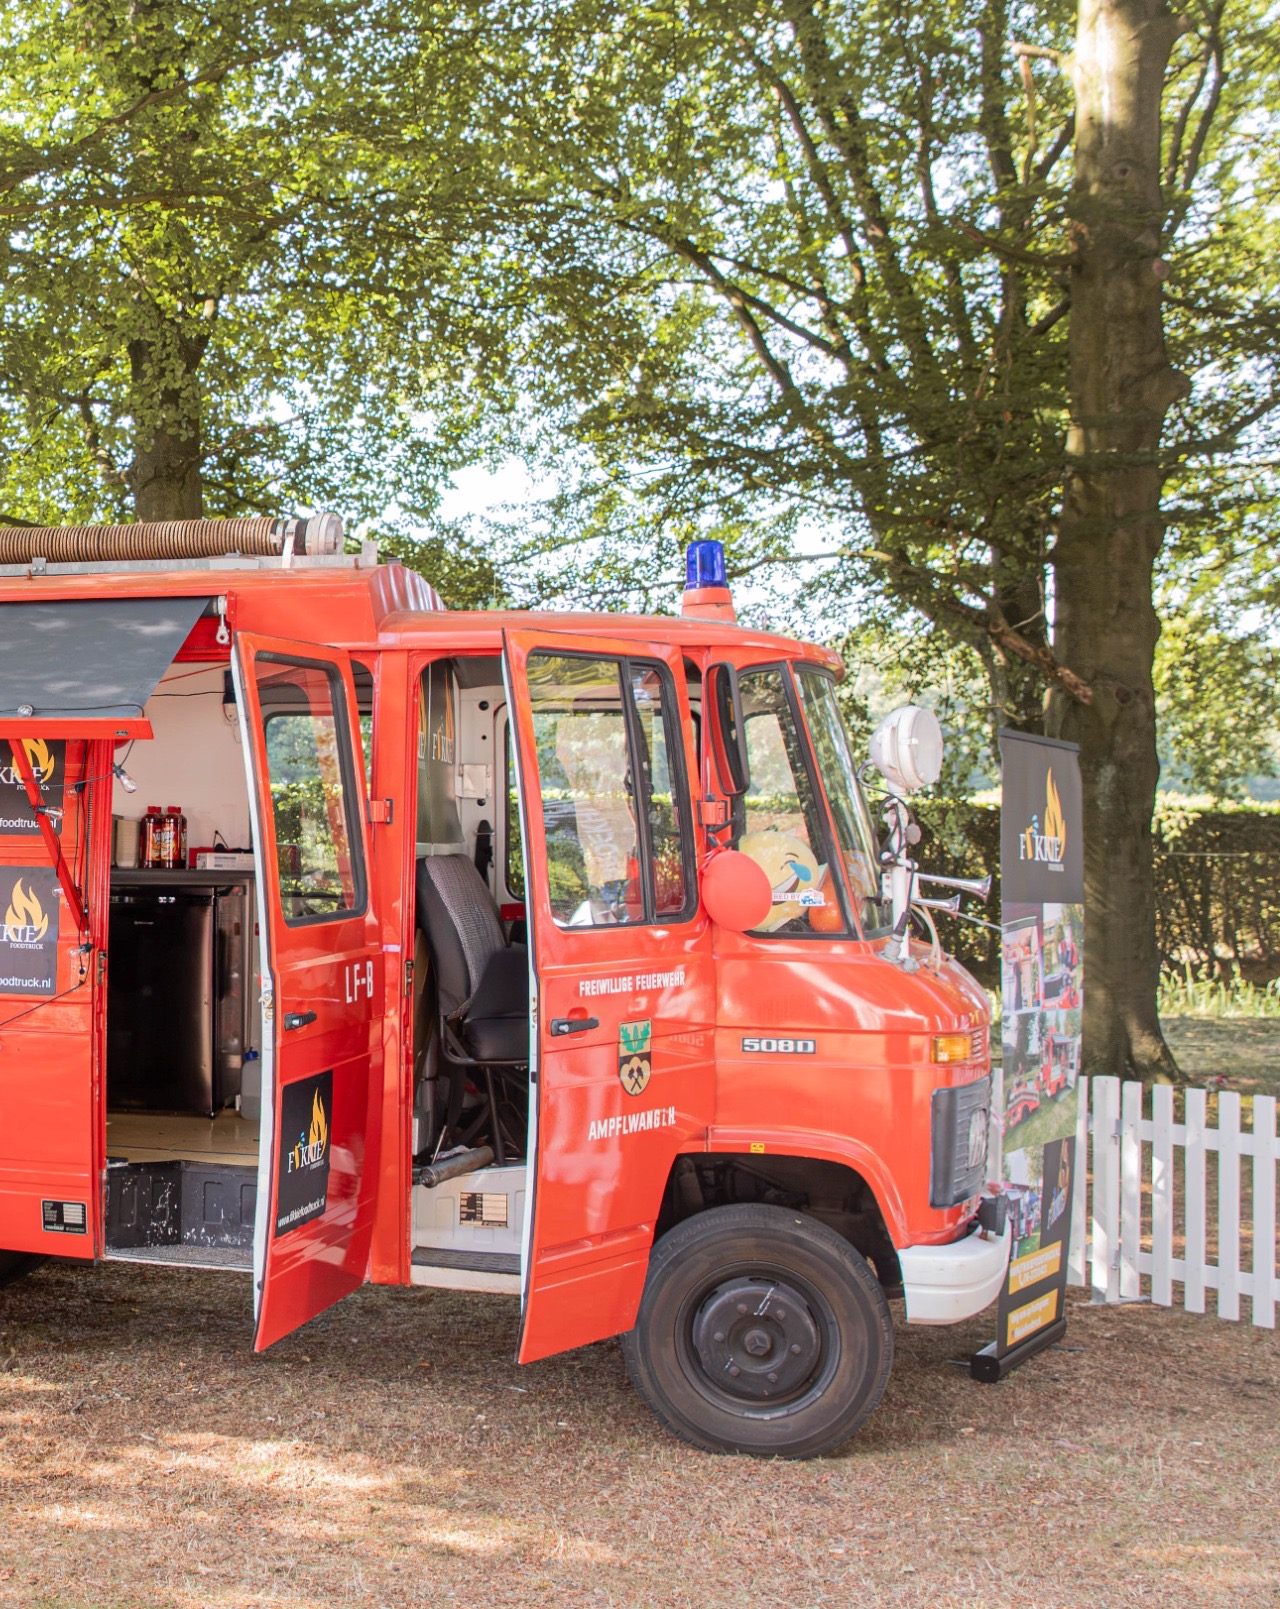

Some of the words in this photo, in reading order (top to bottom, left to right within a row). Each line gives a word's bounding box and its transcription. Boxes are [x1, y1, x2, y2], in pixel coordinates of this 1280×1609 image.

[9, 942, 44, 950] FOODTRUCK
[345, 960, 374, 1004] LF-B
[579, 976, 633, 997] FREIWILLIGE
[636, 971, 685, 991] FEUERWEHR
[742, 1039, 815, 1053] 508D
[588, 1109, 660, 1142] AMPFLWANG
[287, 1138, 323, 1174] FIKKIE
